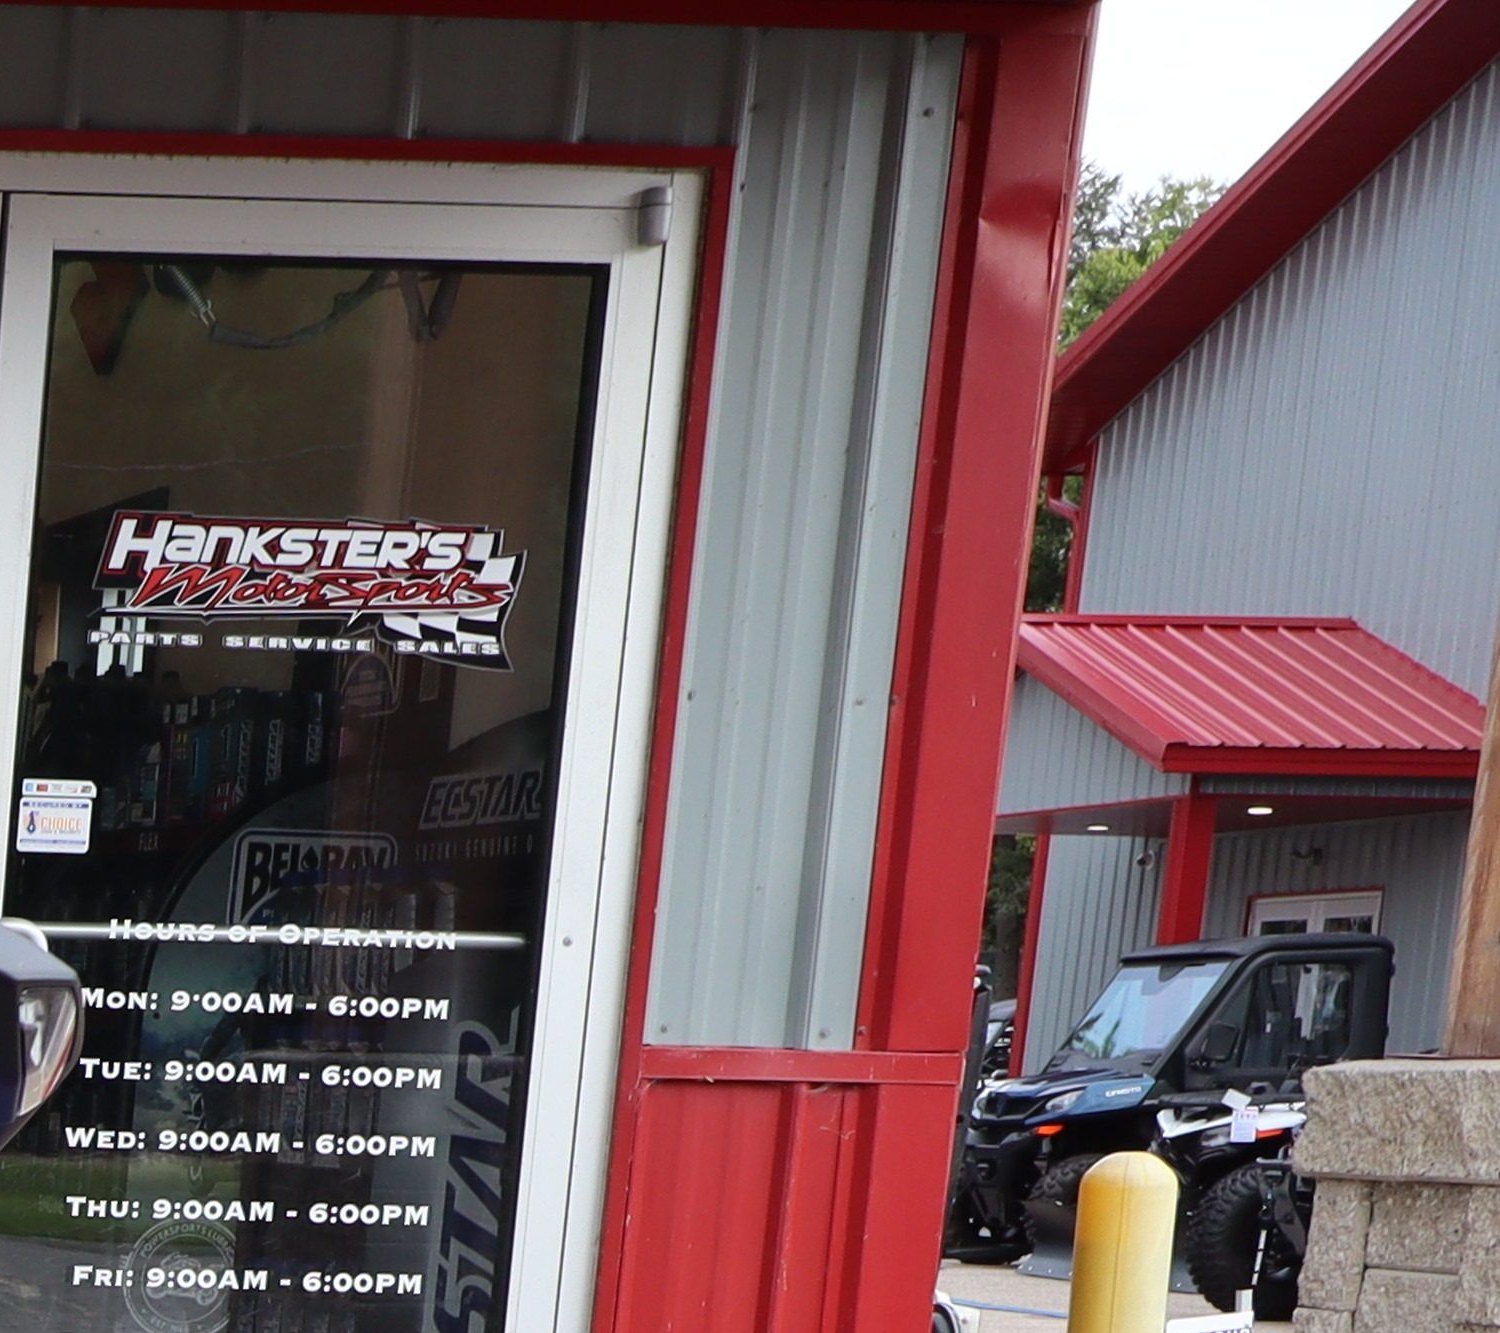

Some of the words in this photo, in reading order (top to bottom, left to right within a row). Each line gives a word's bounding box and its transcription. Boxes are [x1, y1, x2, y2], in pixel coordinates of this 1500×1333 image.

[88, 629, 202, 647] PARTS
[222, 634, 374, 653] SERVICE
[395, 639, 501, 656] SALES
[420, 768, 543, 829] ECSTAR
[41, 817, 81, 830] CHOICE
[108, 918, 215, 943] HOURS
[227, 925, 268, 945] OF
[278, 923, 457, 951] OPERATION
[81, 987, 159, 1010] MON:
[171, 991, 294, 1015] 9:00AM
[328, 996, 450, 1020] 6:00PM
[80, 1057, 152, 1081] TUE:
[164, 1060, 287, 1085] 9:00AM
[321, 1065, 442, 1090] 6:00PM
[65, 1127, 146, 1150] WED:
[158, 1130, 281, 1154] 9:00AM
[315, 1135, 436, 1158] 6:00PM
[66, 1195, 141, 1219] THU:
[152, 1198, 274, 1223] 9:00AM
[308, 1203, 430, 1226] 6:00PM
[72, 1265, 134, 1288] FRI:
[146, 1268, 268, 1292] 9:00AM
[302, 1271, 423, 1295] 6:00PM
